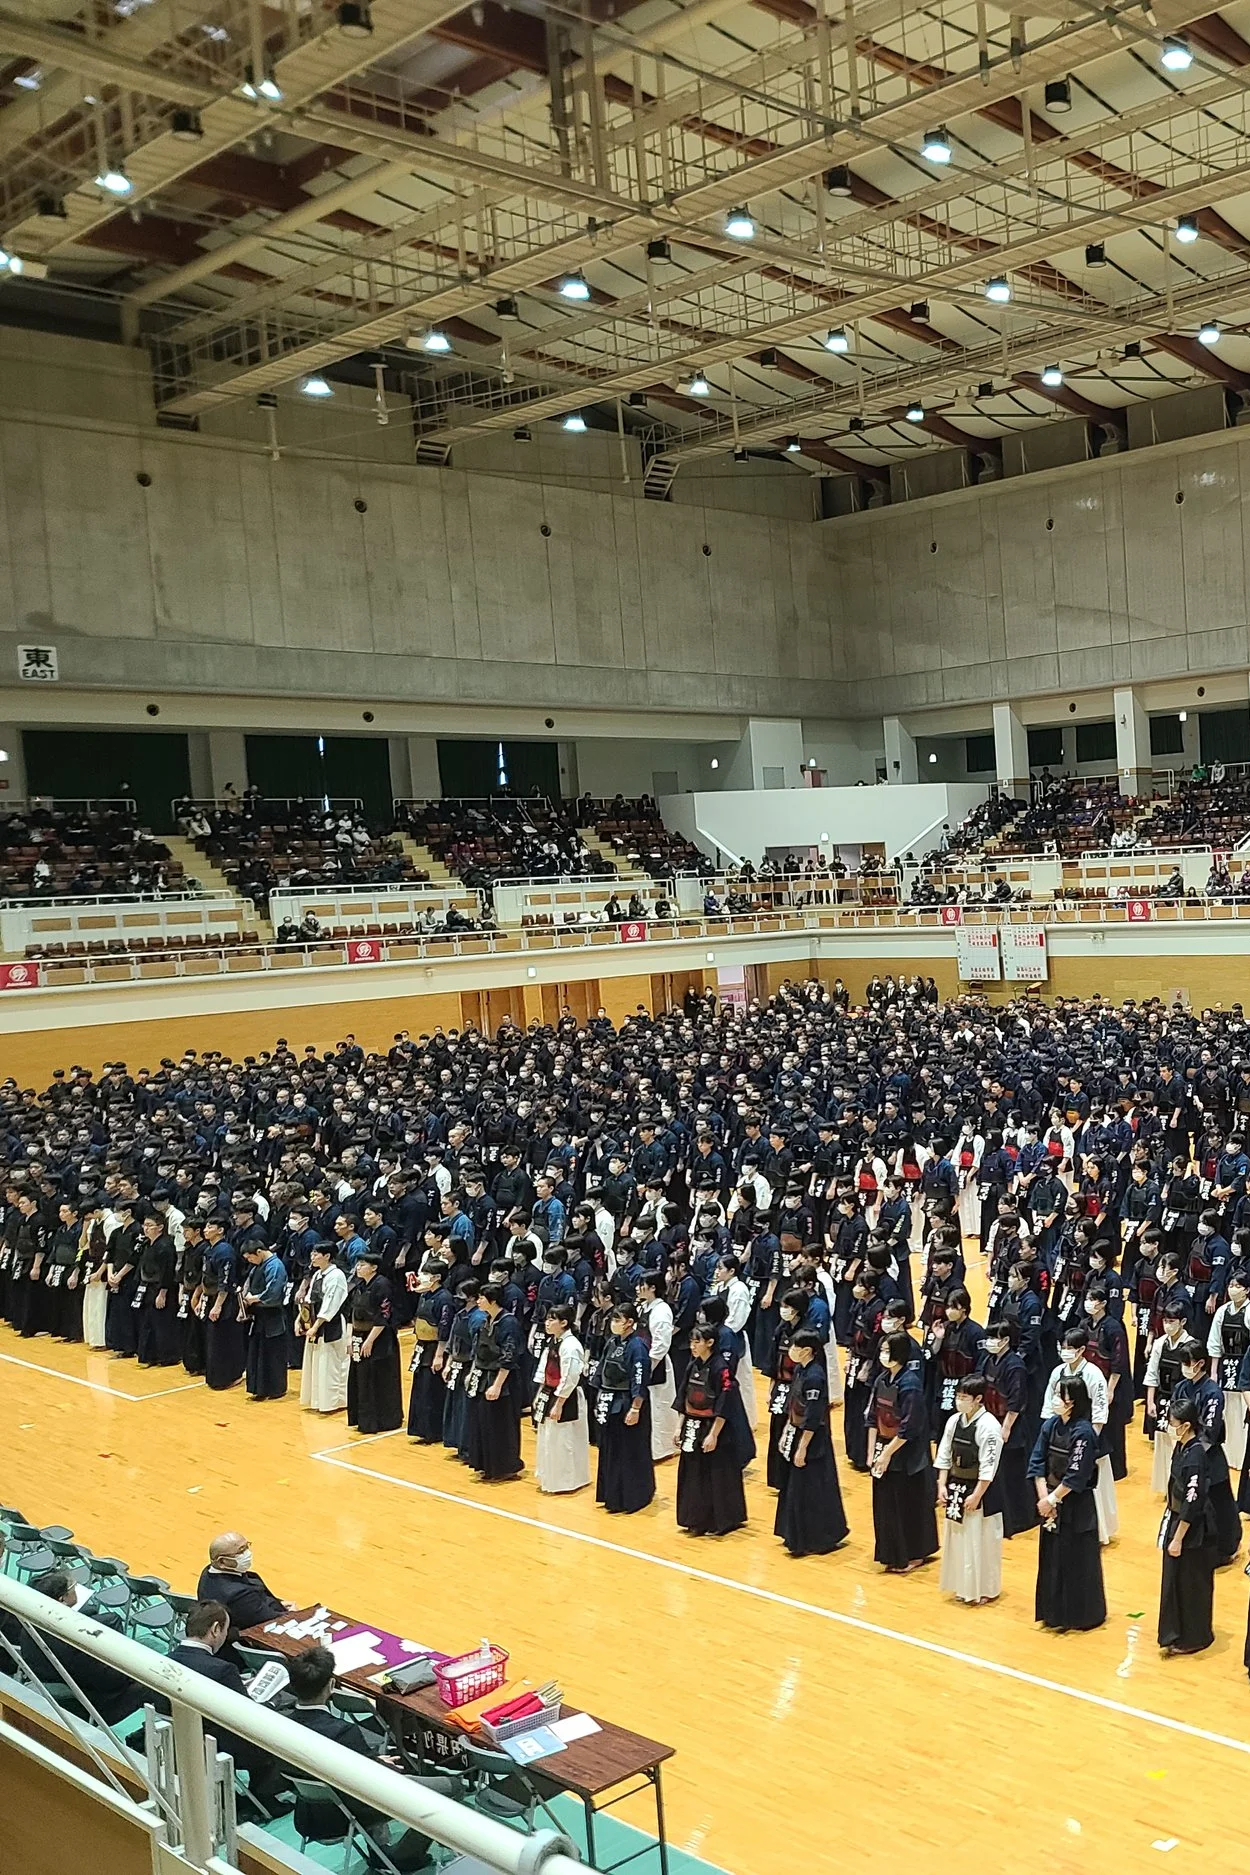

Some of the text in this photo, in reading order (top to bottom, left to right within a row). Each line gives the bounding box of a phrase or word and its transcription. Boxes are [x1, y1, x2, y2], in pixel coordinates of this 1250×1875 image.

[23, 648, 54, 668] 東
[22, 669, 55, 679] EAST
[945, 1490, 963, 1520] 小林
